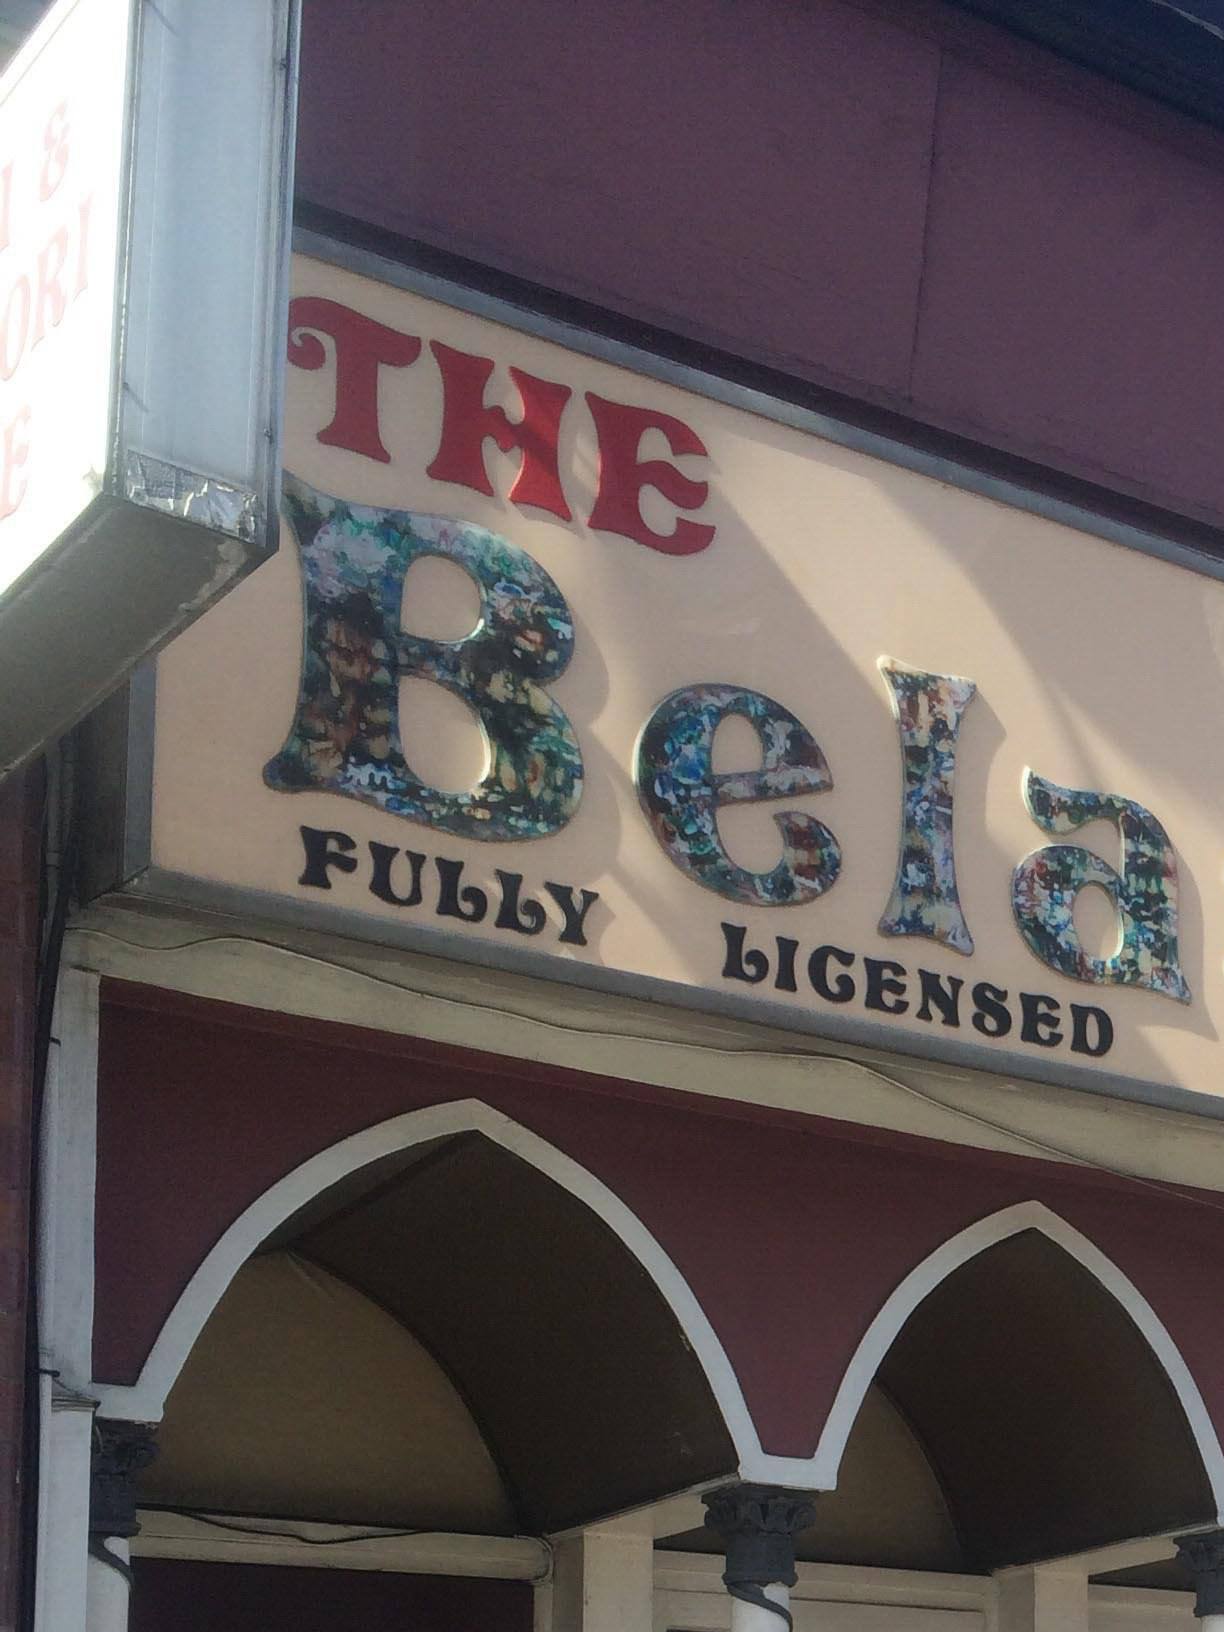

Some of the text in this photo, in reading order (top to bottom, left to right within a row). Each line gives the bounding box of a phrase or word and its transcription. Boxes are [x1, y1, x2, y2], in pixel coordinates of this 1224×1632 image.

[287, 296, 716, 556] THE
[299, 825, 1114, 1057] FULLY LICENSED
